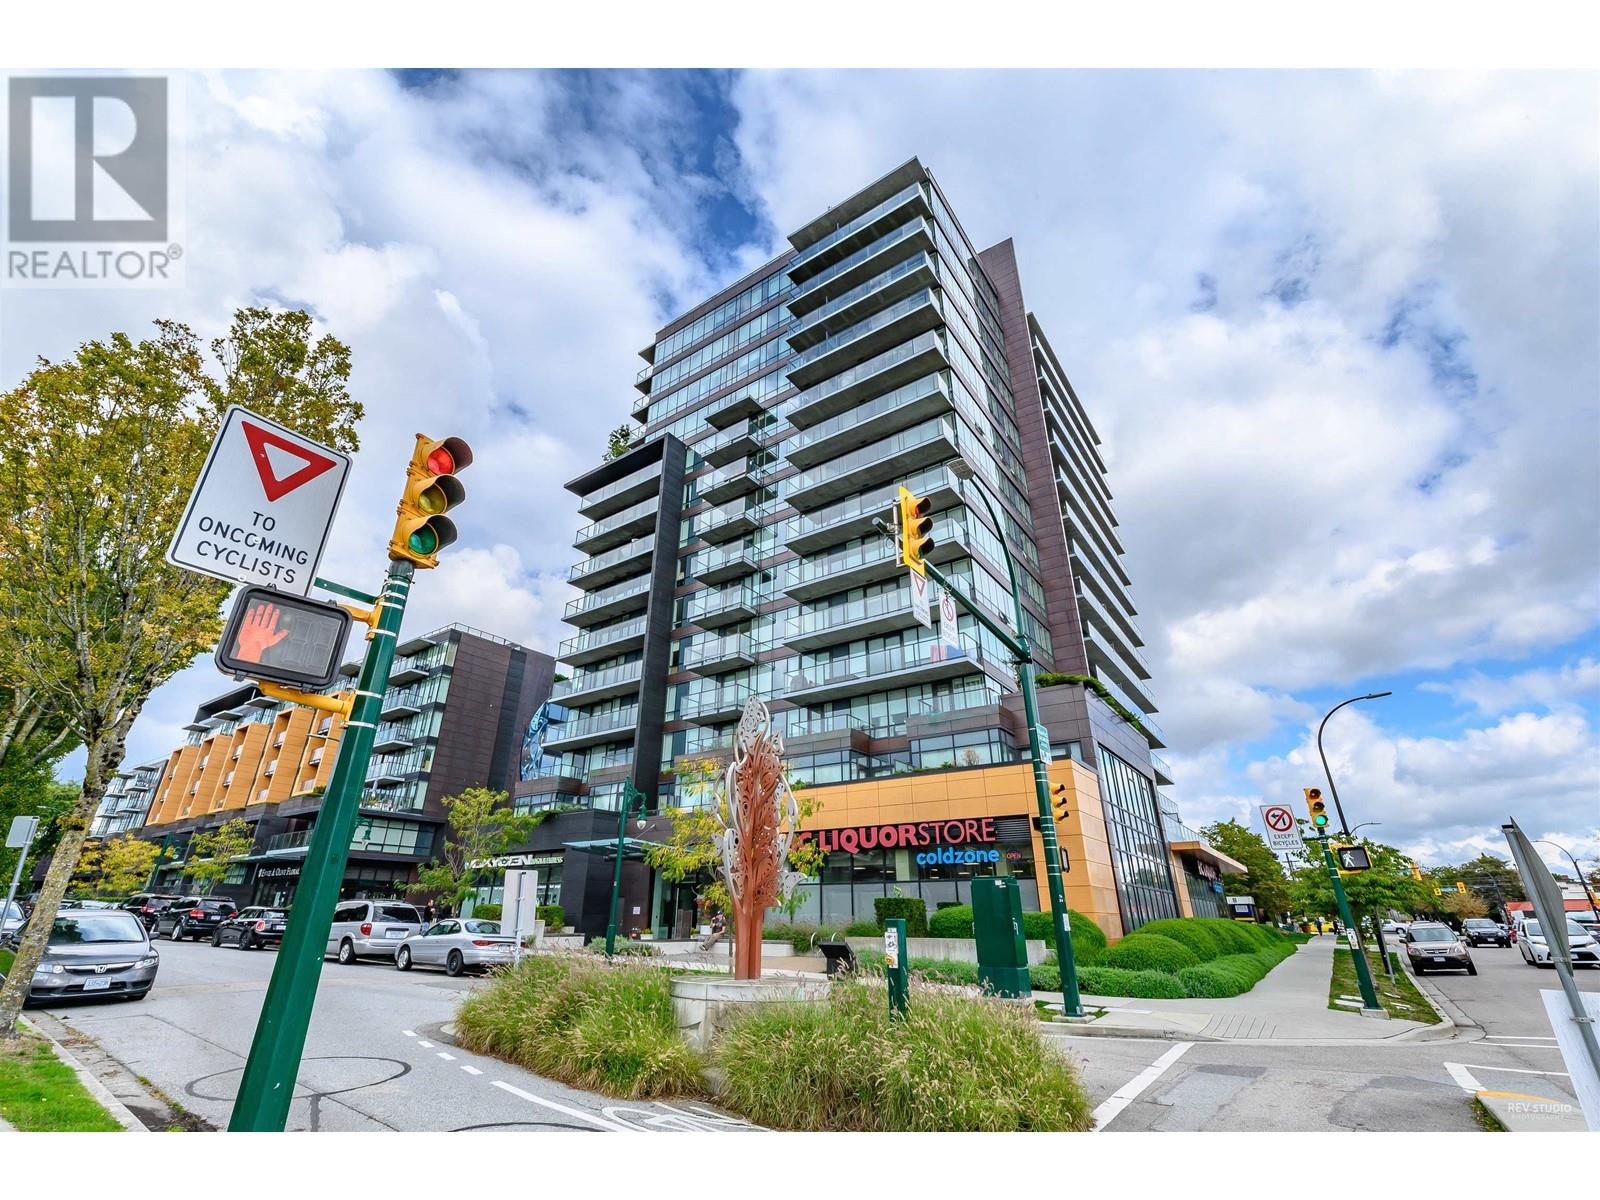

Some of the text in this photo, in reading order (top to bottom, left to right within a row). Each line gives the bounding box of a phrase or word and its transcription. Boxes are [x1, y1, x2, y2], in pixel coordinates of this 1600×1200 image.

[253, 511, 275, 531] TO
[199, 516, 309, 565] ONCOMING
[196, 540, 296, 584] CYCLISTS
[916, 847, 1000, 866] coldzone
